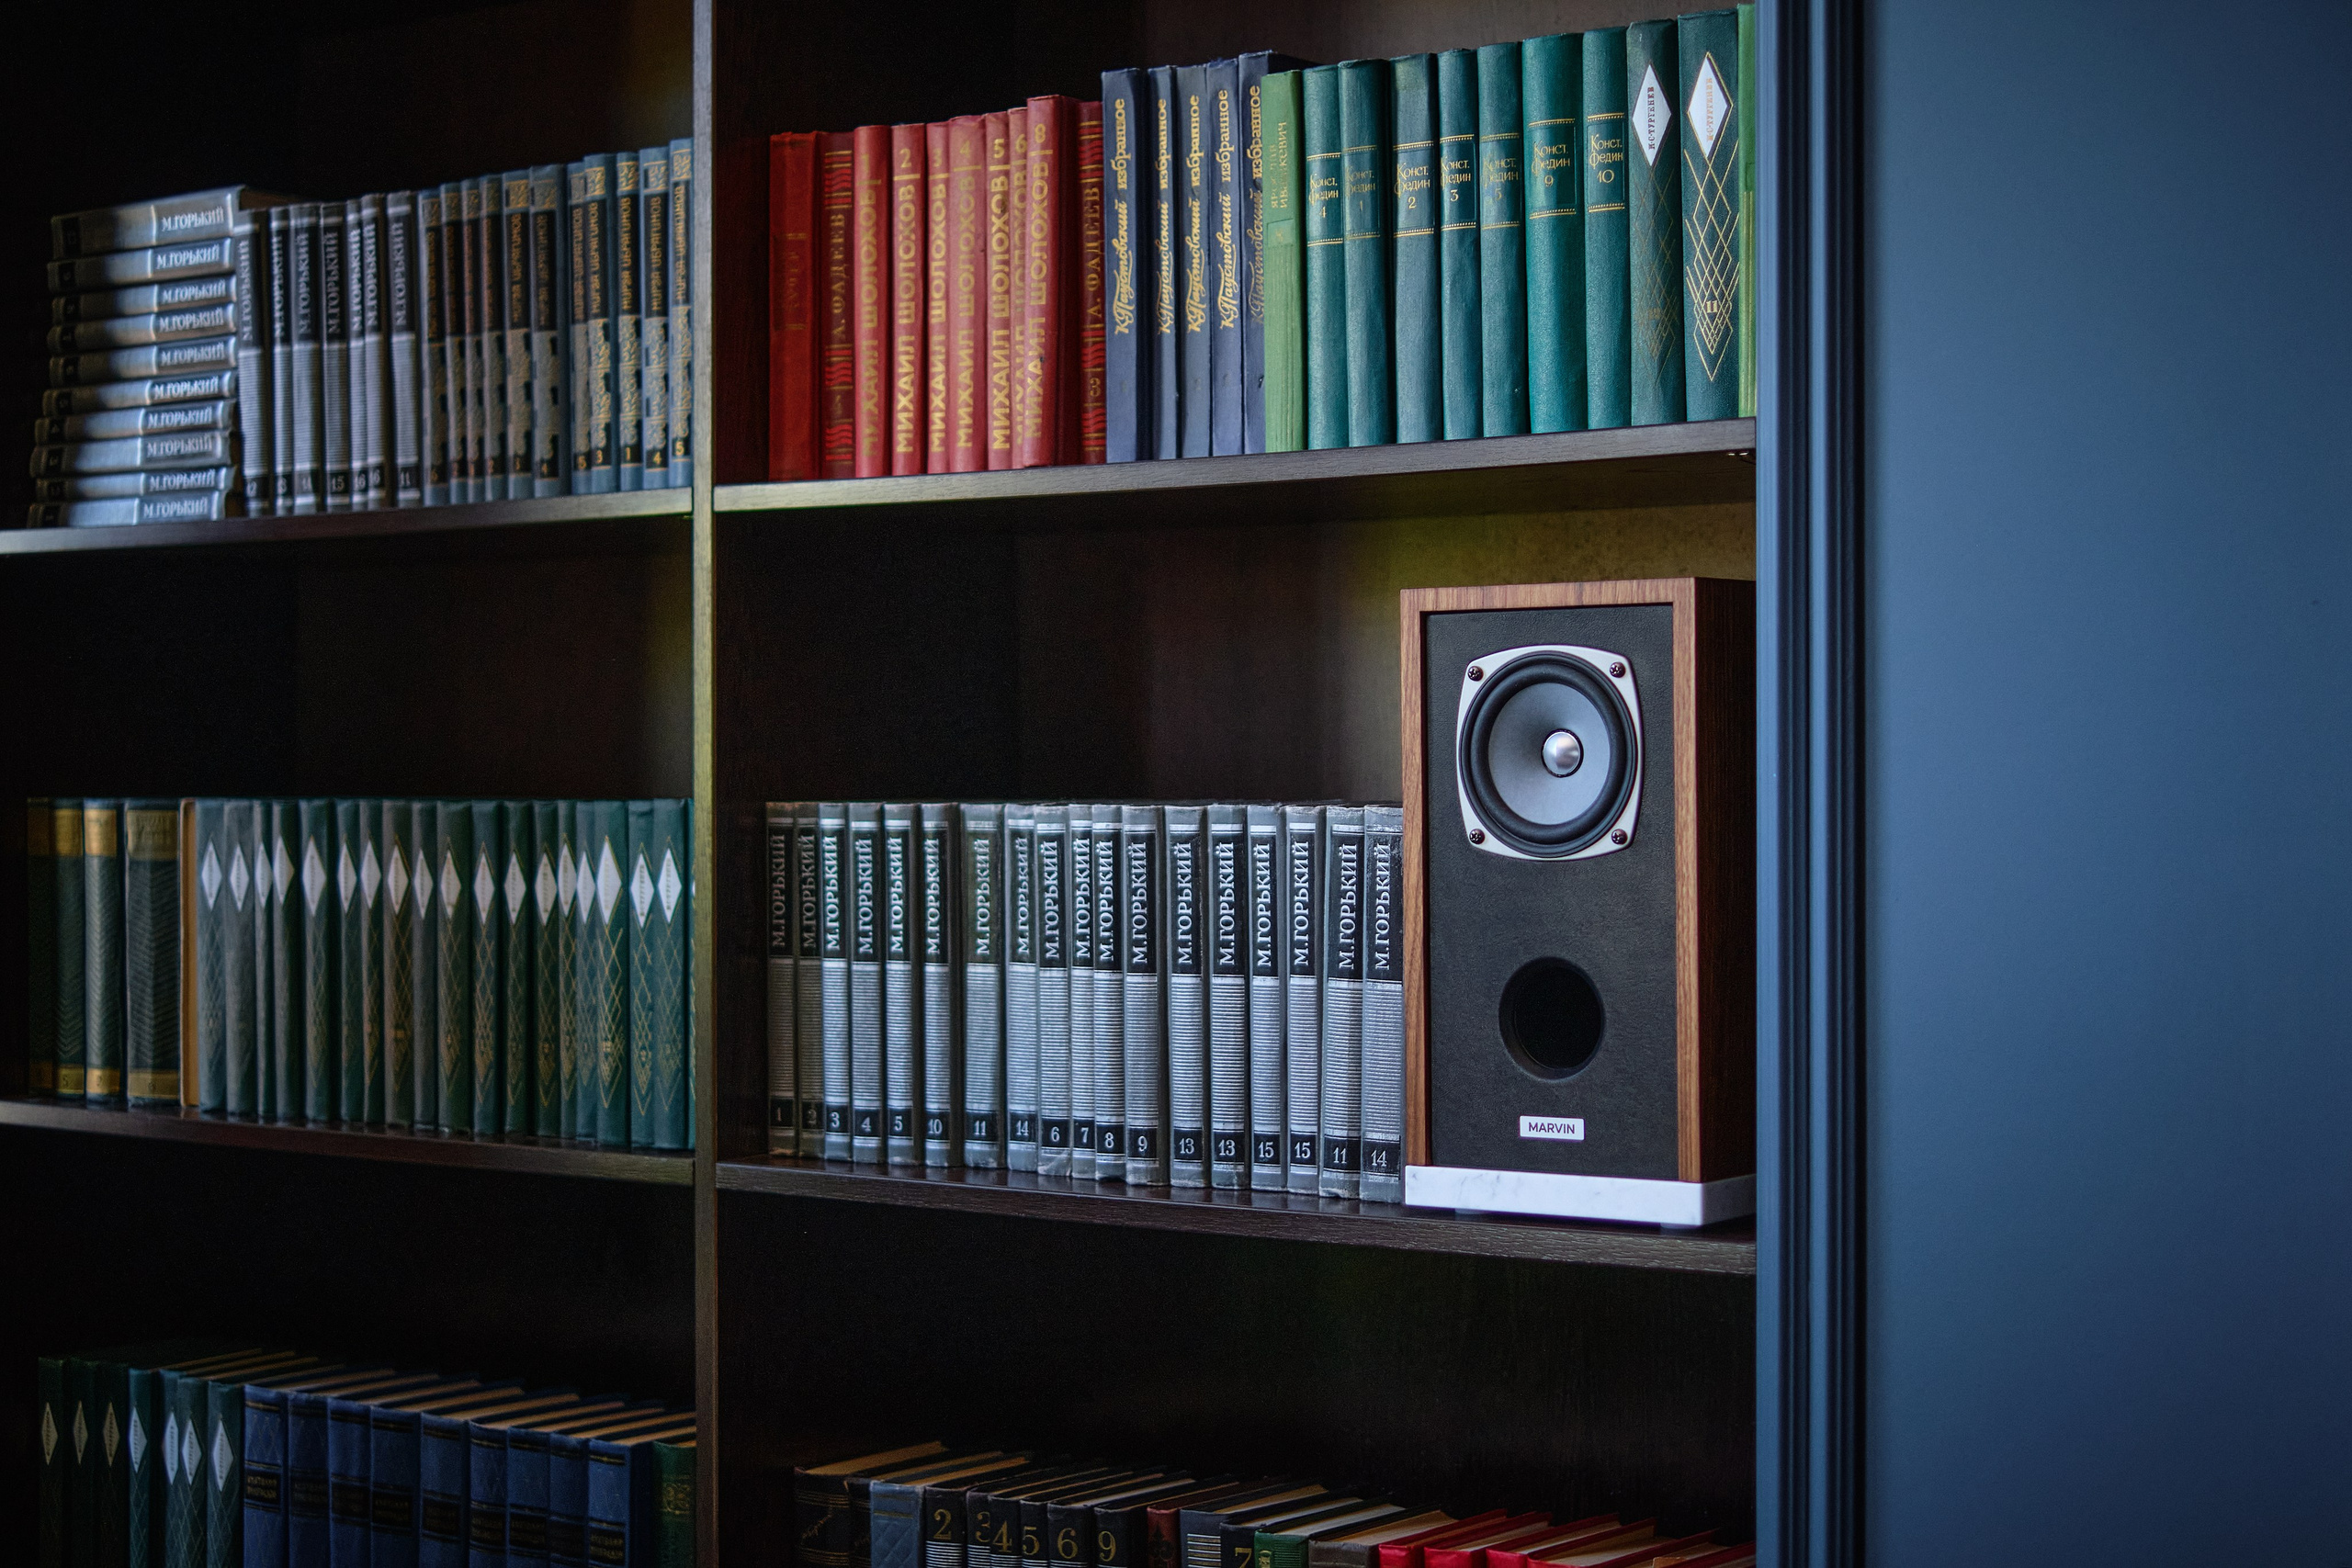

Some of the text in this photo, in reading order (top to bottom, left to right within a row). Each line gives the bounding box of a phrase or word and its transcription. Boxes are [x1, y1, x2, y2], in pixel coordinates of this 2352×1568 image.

[1035, 123, 1046, 143] 8
[1186, 95, 1204, 186] избранное
[1215, 89, 1235, 183] избранное
[1246, 85, 1264, 179] избранное
[1591, 134, 1623, 152] Конст.
[959, 140, 971, 159] 4
[993, 139, 1005, 158] 5
[1015, 134, 1027, 153] 6
[1111, 98, 1131, 190] избранное
[1155, 99, 1171, 190] избранное
[1533, 140, 1568, 158] Конст.
[899, 148, 912, 167] 2
[933, 149, 944, 167] 3
[1441, 155, 1470, 173] Конст.
[1482, 152, 1516, 171] Конст.
[1309, 173, 1338, 189] Конст.
[1345, 164, 1374, 182] Конст.
[1396, 161, 1429, 180] Конст.
[1544, 175, 1554, 187] 9
[1597, 169, 1614, 183] 10
[1408, 197, 1417, 209] 2
[1450, 189, 1459, 201] 3
[1495, 187, 1502, 200] 5
[162, 206, 224, 231] М.ГОРЬКИЙ
[1319, 205, 1327, 219] 4
[155, 243, 220, 270] М.ГОРЬКИЙ
[830, 213, 850, 314] ФАДЕЕВ
[860, 189, 878, 328] ШОЛОХОВ
[1085, 187, 1105, 319] А. ФАДЕЕВ
[162, 279, 225, 304] М.ГОРЬКИЙ
[1025, 162, 1048, 438] МИХАИЛ ШОЛОХОВ
[956, 175, 976, 447] МИХАИЛ ШОЛОХОВ
[990, 175, 1011, 449] МИХАИЛ ШОЛОХОВ
[1706, 300, 1718, 313] 11
[159, 307, 224, 333] М.ГОРЬКИЙ
[897, 185, 916, 452] МИХАИЛ ШОЛОХОВ
[931, 184, 946, 452] МИХАИЛ ШОЛОХОВ
[161, 342, 225, 367] М.ГОРЬКИЙ
[154, 376, 219, 400] М.ГОРЬКИЙ
[1089, 377, 1102, 398] 3
[147, 407, 212, 430] М.ГОРЬКИЙ
[147, 434, 212, 457] М.ГОРЬКИЙ
[625, 446, 631, 459] 1
[675, 441, 684, 455] 5
[653, 451, 662, 465] 4
[150, 468, 215, 492] М.ГОРЬКИЙ
[332, 475, 345, 491] 15
[400, 470, 411, 487] 11
[143, 497, 208, 519] М.ГОРЬКИЙ
[772, 834, 786, 948] М.ГОРЬКИЙ
[799, 834, 817, 949] М.ГОРЬКИЙ
[822, 835, 841, 951] М.ГОРЬКИЙ
[855, 839, 873, 954] М.ГОРЬКИЙ
[888, 837, 903, 953] М.ГОРЬКИЙ
[924, 838, 941, 955] М.ГОРЬКИЙ
[974, 839, 990, 955] М.ГОРЬКИЙ
[1015, 837, 1030, 955] М.ГОРЬКИЙ
[1040, 840, 1060, 959] М.ГОРЬКИЙ
[1073, 838, 1091, 958] М.ГОРЬКИЙ
[1096, 840, 1114, 962] М.ГОРЬКИЙ
[1128, 841, 1148, 964] М.ГОРЬКИЙ
[1173, 842, 1193, 964] М.ГОРЬКИЙ
[1216, 842, 1236, 965] М.ГОРЬКИЙ
[1254, 843, 1272, 967] М.ГОРЬКИЙ
[1291, 840, 1309, 965] М.ГОРЬКИЙ
[1339, 843, 1358, 970] М.ГОРЬКИЙ
[1374, 843, 1392, 970] М.ГОРЬКИЙ
[806, 1111, 817, 1126] 2
[830, 1111, 841, 1129] 3
[860, 1116, 872, 1132] 4
[894, 1115, 903, 1132] 5
[928, 1118, 943, 1134] 10
[974, 1121, 987, 1136] 11
[1015, 1121, 1029, 1136] 14
[1529, 1122, 1575, 1134] MARVIN
[1050, 1126, 1060, 1143] 6
[1080, 1126, 1090, 1144] 7
[1104, 1132, 1114, 1148] 8
[1137, 1135, 1148, 1153] 9
[1180, 1137, 1194, 1155] 13
[1219, 1139, 1236, 1156] 13
[1259, 1141, 1274, 1158] 15
[1295, 1141, 1311, 1158] 15
[1333, 1147, 1347, 1164] 11
[1371, 1149, 1387, 1168] 14
[933, 1508, 953, 1540] 2
[976, 1511, 990, 1540] 3
[991, 1520, 1012, 1553] 4
[1022, 1526, 1040, 1556] 5
[1057, 1528, 1078, 1559] 6
[1097, 1529, 1117, 1562] 9
[1234, 1547, 1253, 1568] 7
